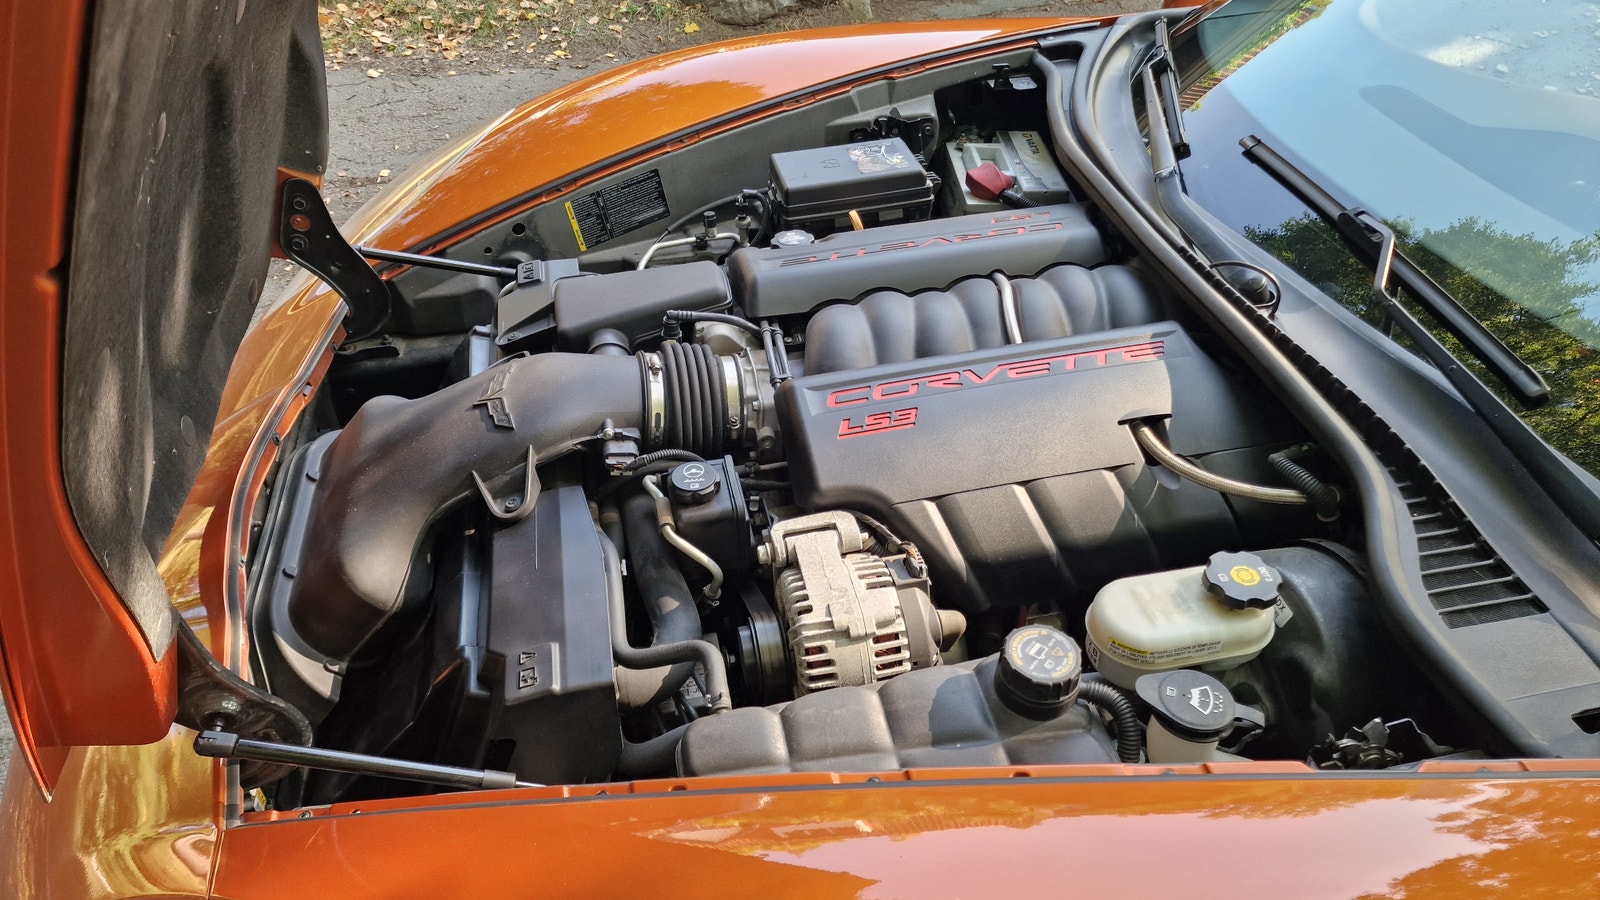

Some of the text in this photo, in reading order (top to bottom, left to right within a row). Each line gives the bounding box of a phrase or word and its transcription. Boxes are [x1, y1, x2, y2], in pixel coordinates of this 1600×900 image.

[1025, 138, 1040, 154] VARTA
[779, 222, 1063, 268] CORVETTE
[826, 340, 1166, 409] CORVETTE
[837, 406, 919, 438] LS3
